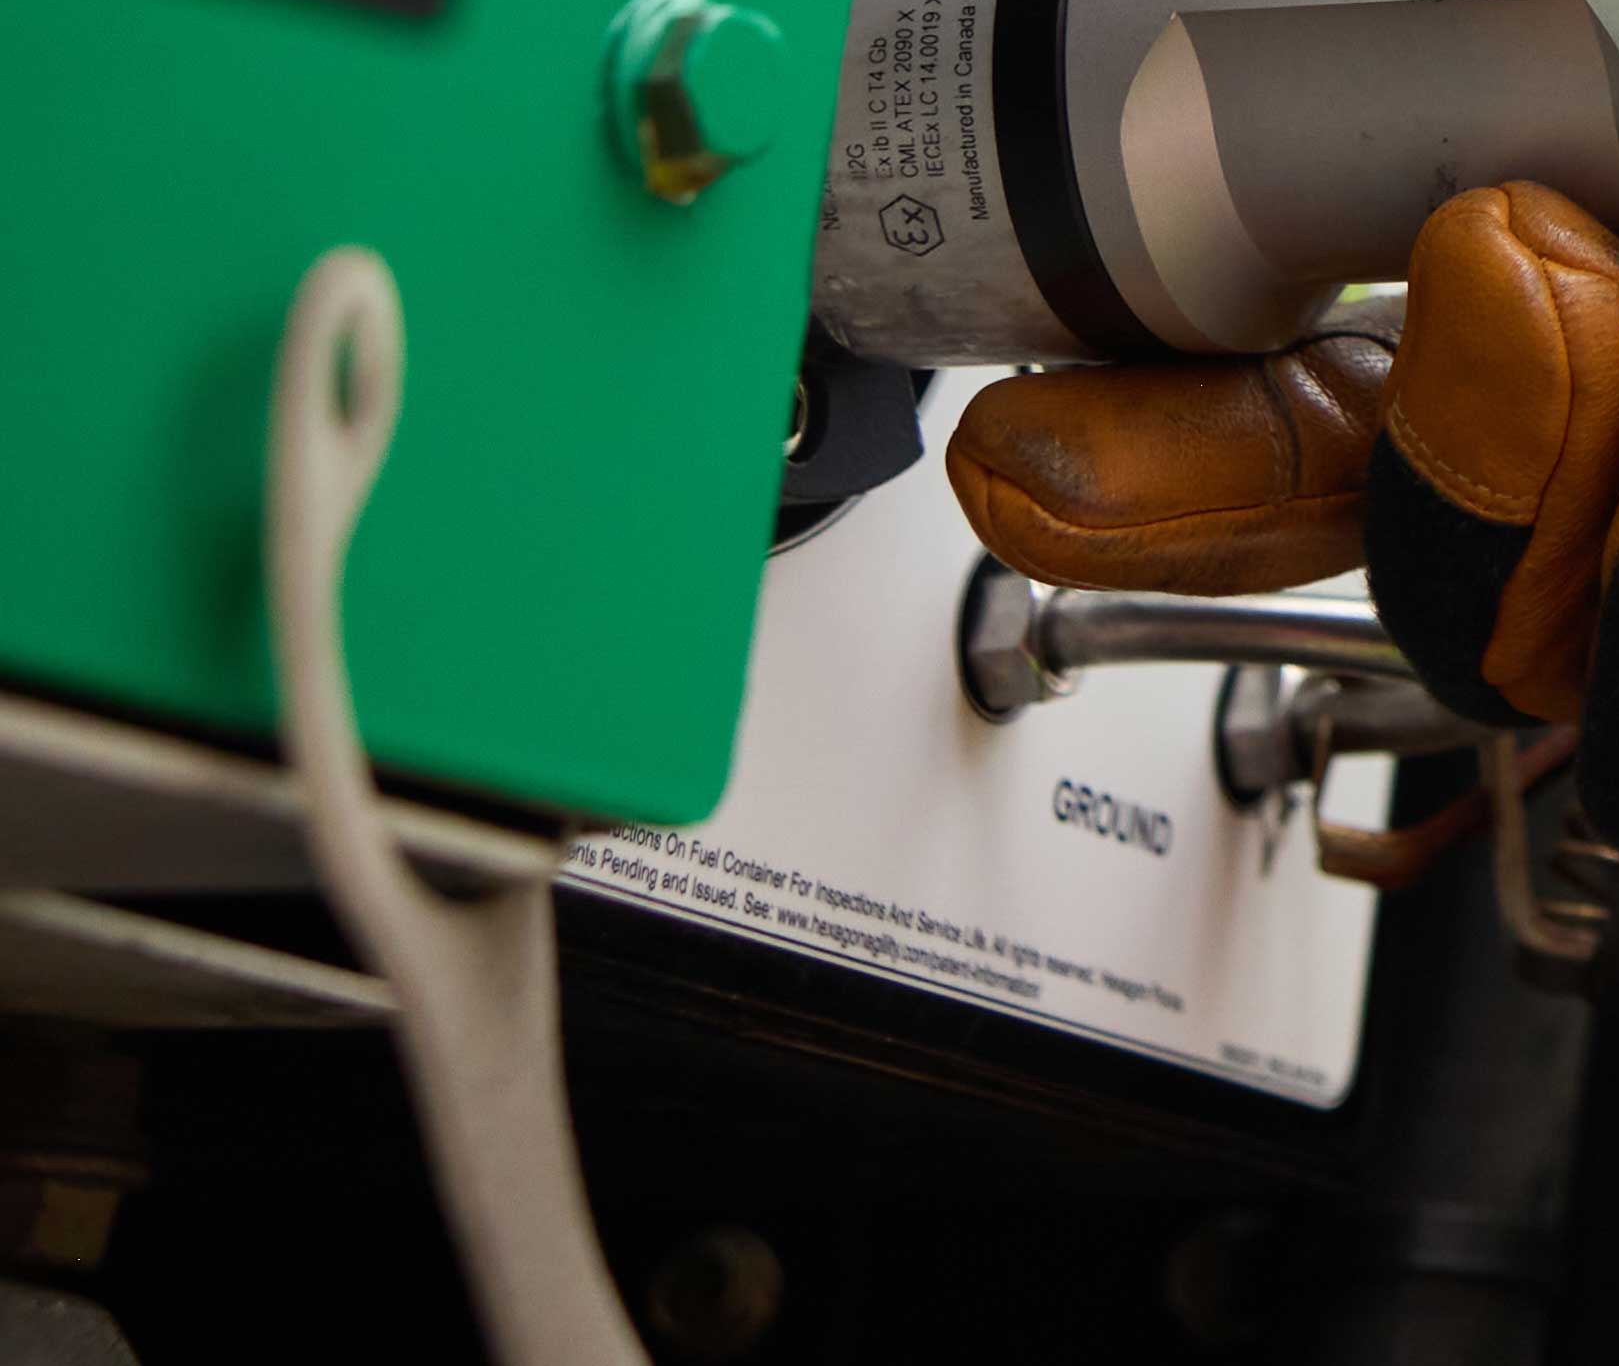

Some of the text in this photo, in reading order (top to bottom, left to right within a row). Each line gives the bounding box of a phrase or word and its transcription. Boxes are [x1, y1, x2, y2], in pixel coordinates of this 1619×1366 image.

[869, 36, 888, 63] Gb
[919, 11, 941, 84] 14.0019
[954, 4, 977, 76] Canada
[868, 71, 886, 92] T4
[894, 8, 920, 178] CML ATEX 2090 X
[920, 90, 939, 116] LC
[953, 84, 973, 100] in
[923, 122, 945, 178] IECEx
[958, 105, 989, 221] Manufactured
[1053, 777, 1174, 857] GROUND
[600, 847, 659, 891] Pending
[662, 872, 687, 895] and
[691, 875, 739, 912] Issued.
[743, 891, 773, 920] See:
[665, 832, 687, 857] On
[690, 839, 720, 868] Fuel
[722, 850, 788, 888] Container
[790, 871, 813, 897] For
[814, 880, 887, 921] Inspections
